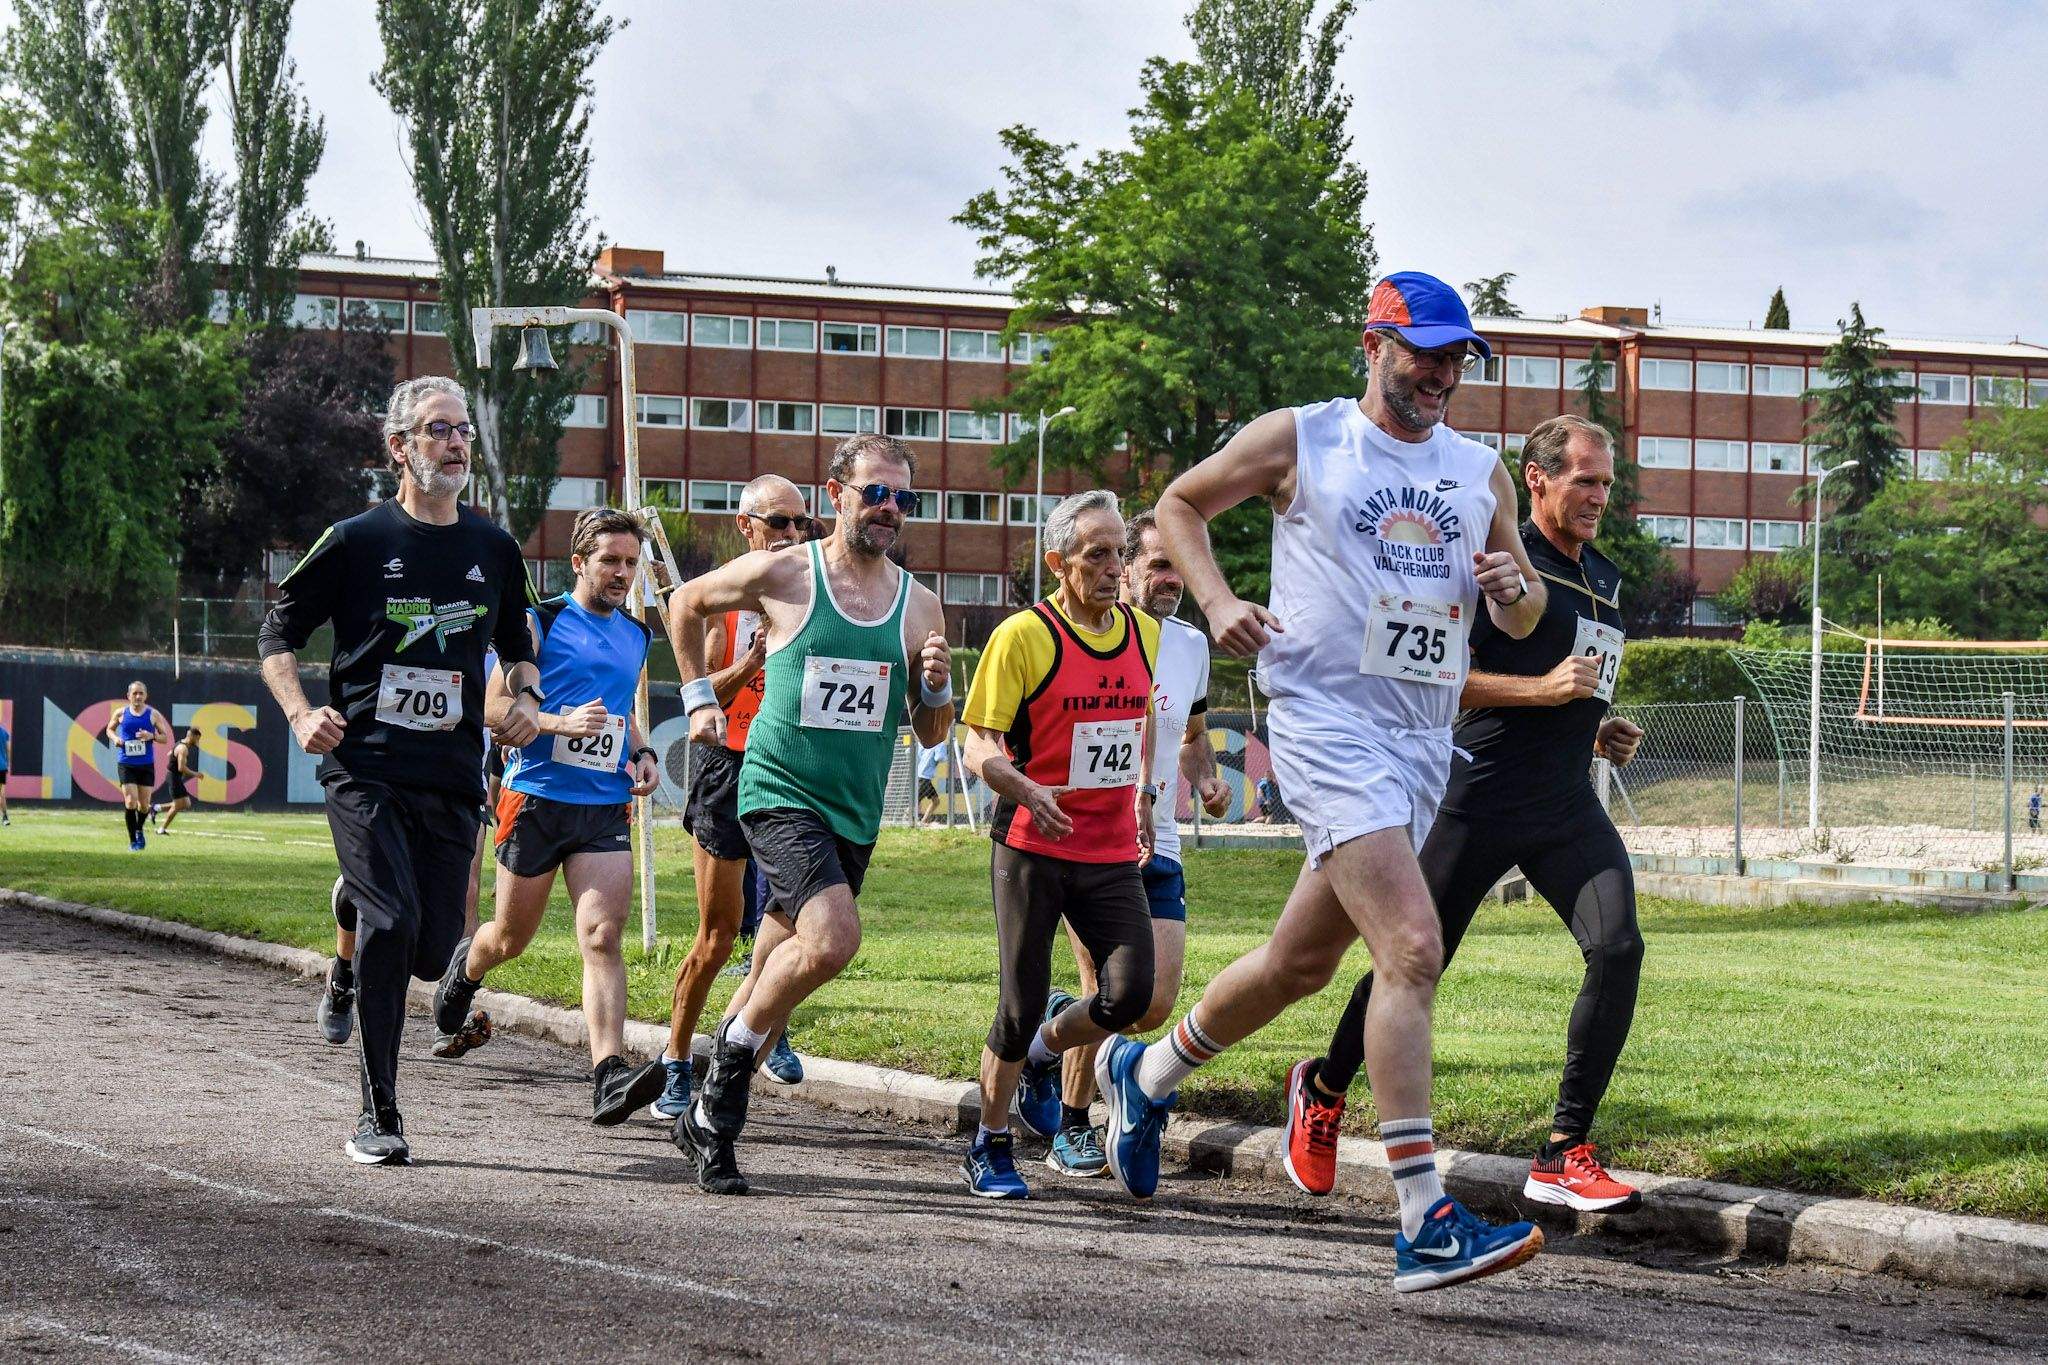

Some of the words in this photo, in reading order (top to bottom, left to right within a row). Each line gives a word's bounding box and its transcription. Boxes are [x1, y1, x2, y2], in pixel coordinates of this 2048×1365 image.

[1439, 478, 1459, 488] NIKE
[1355, 487, 1398, 536] SANTA
[1401, 487, 1461, 543] MONICA
[1378, 540, 1412, 560] TRACK
[1415, 547, 1444, 562] CLUB
[386, 603, 431, 614] MADRID
[437, 600, 470, 611] MARATÓN
[1386, 620, 1446, 664] 735
[1438, 670, 1456, 680] 2023
[395, 688, 448, 719] 709
[819, 681, 875, 714] 724
[567, 733, 613, 758] 829
[1087, 743, 1132, 773] 742
